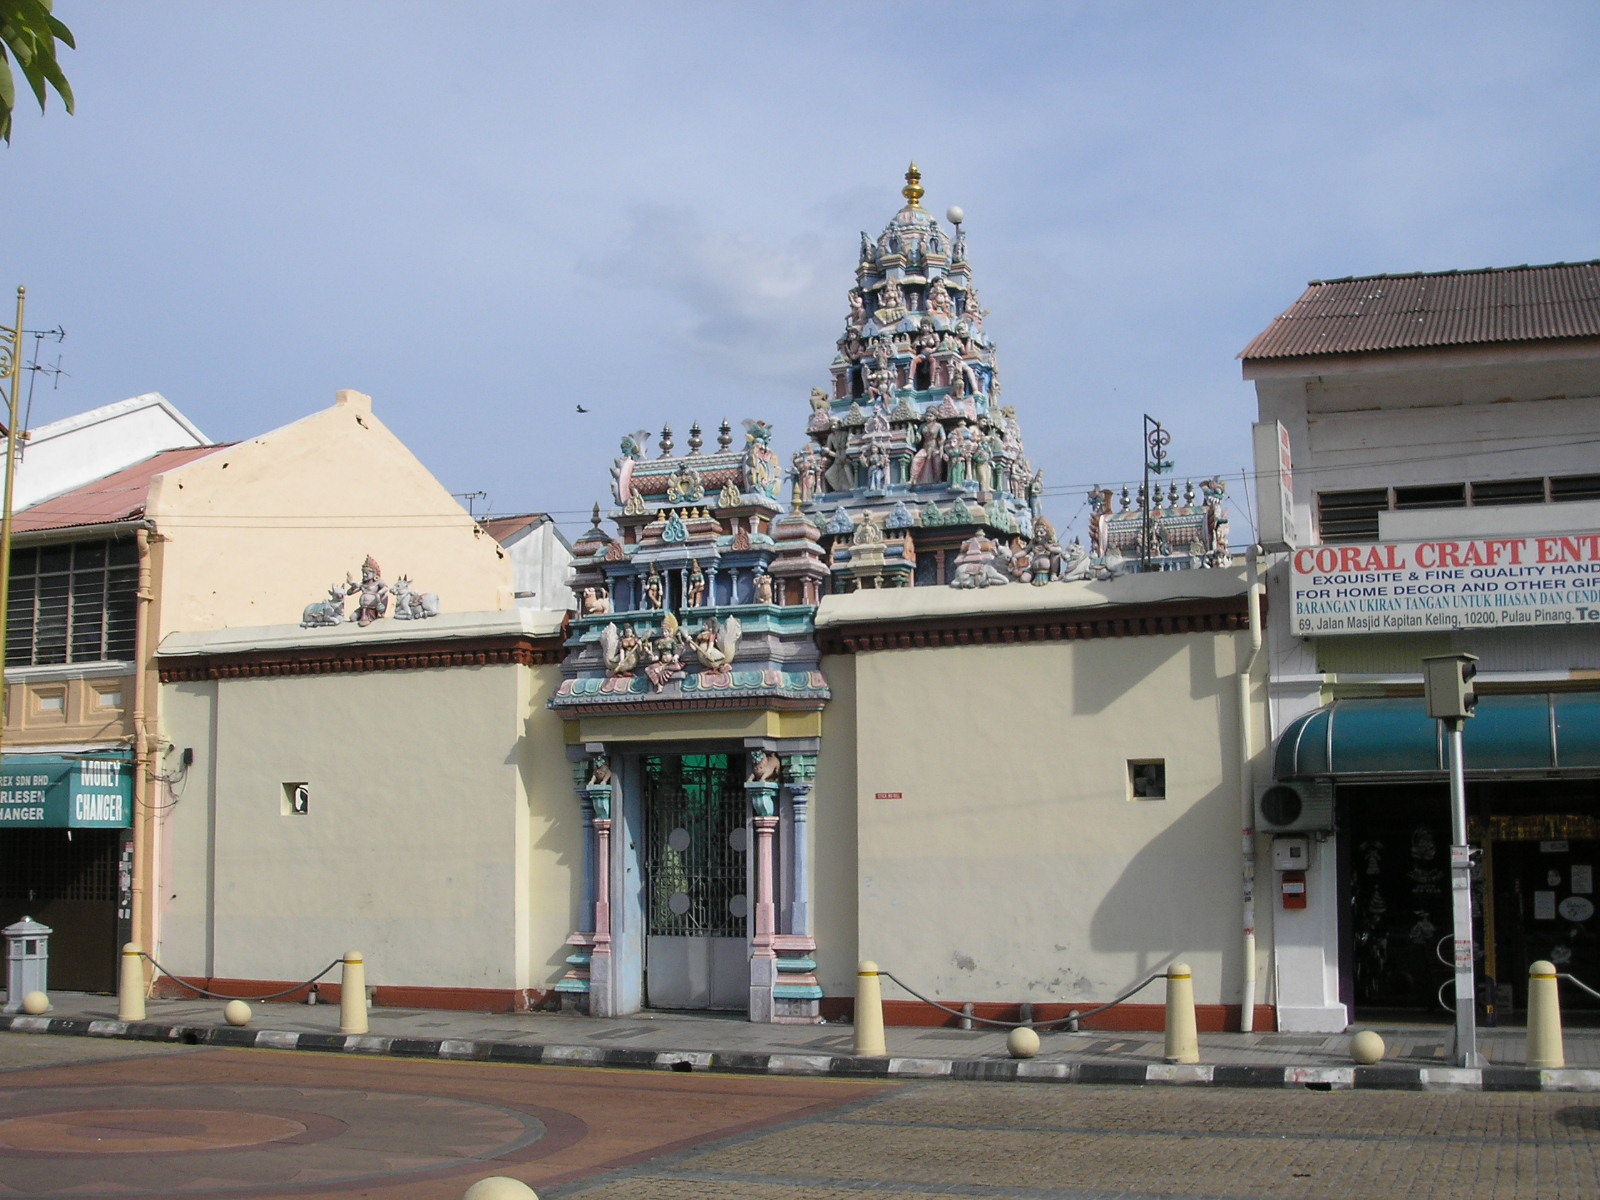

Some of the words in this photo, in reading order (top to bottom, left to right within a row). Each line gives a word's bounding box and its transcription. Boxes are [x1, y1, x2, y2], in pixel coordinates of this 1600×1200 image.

[1294, 545, 1405, 574] CORAL
[1415, 539, 1527, 569] CRAFT
[1536, 535, 1600, 564] ENT
[1313, 572, 1403, 585] EXQUISITE
[1409, 570, 1420, 581] &
[1426, 569, 1464, 580] FINE
[1471, 566, 1545, 579] QUALITY
[1552, 563, 1600, 575] HAND
[1296, 588, 1330, 600] FOR
[1337, 586, 1388, 598] HOME
[1394, 583, 1455, 596] DECOR
[1462, 581, 1498, 593] AND
[1504, 579, 1566, 591] OTHER
[1571, 577, 1600, 589] GIF
[1296, 598, 1356, 615] BARANGAN
[1359, 596, 1401, 613] UKIRAN
[1404, 594, 1450, 611] TANGAN
[1453, 592, 1493, 609] UNTUK
[1495, 590, 1537, 608] HIASAN
[1540, 589, 1564, 605] DAN
[1299, 617, 1314, 631] 69,
[1316, 616, 1344, 629] Jalan
[1347, 615, 1381, 631] Masjid
[1384, 613, 1423, 630] Kapitan
[1426, 612, 1461, 629] Keling,
[1464, 611, 1499, 626] 10200,
[1502, 609, 1531, 623] Pulau
[1534, 608, 1575, 624] Pinang.
[16, 776, 31, 786] SDN
[33, 775, 48, 786] BHD
[81, 760, 120, 787] MONEY
[76, 794, 122, 821] CHANGER
